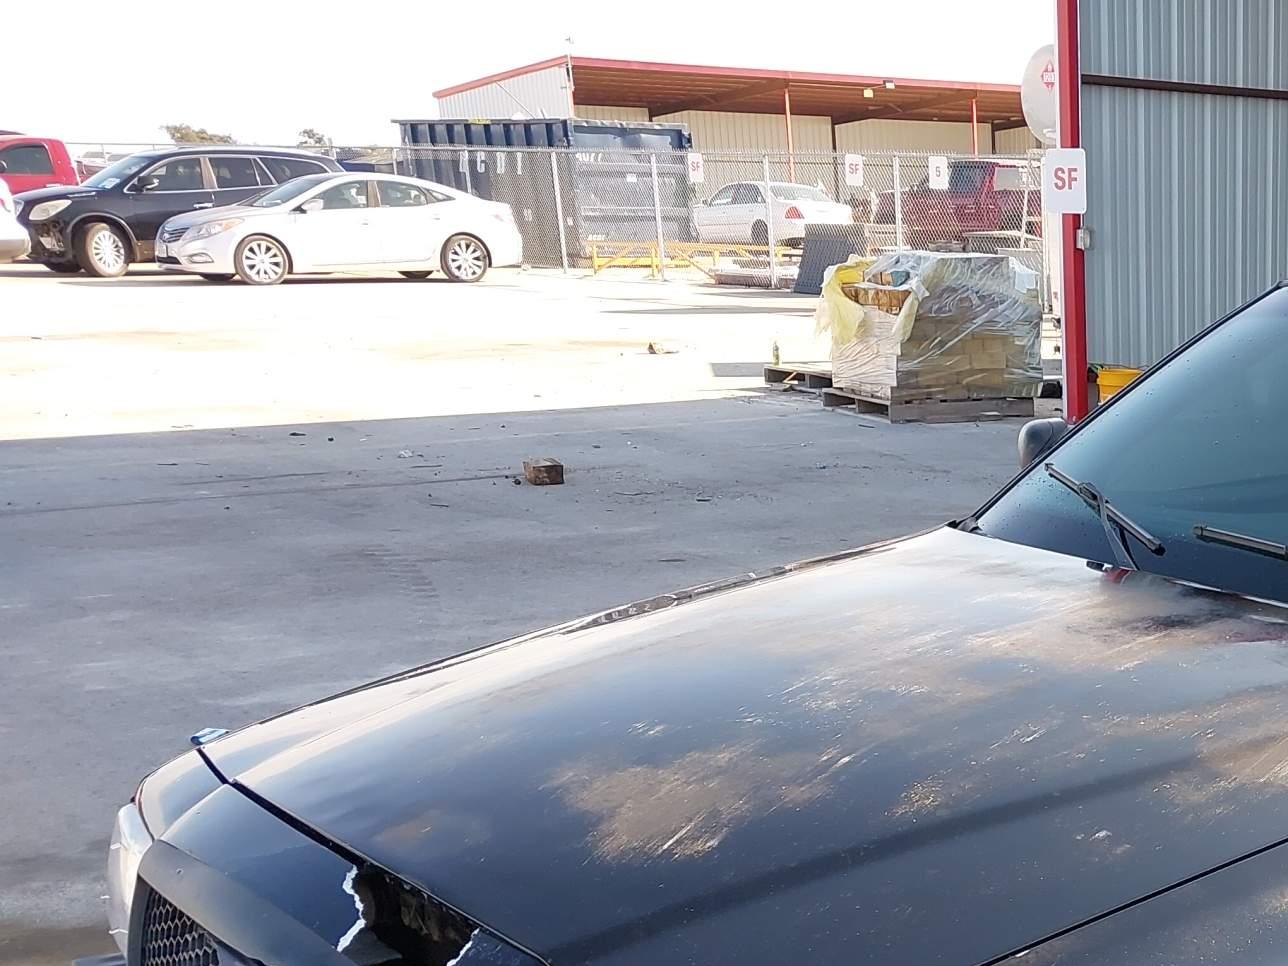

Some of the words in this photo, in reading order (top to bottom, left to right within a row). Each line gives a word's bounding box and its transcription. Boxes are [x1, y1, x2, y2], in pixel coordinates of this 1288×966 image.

[690, 160, 700, 172] SF
[848, 162, 860, 175] SF
[935, 166, 941, 178] 5
[1053, 166, 1078, 191] SF
